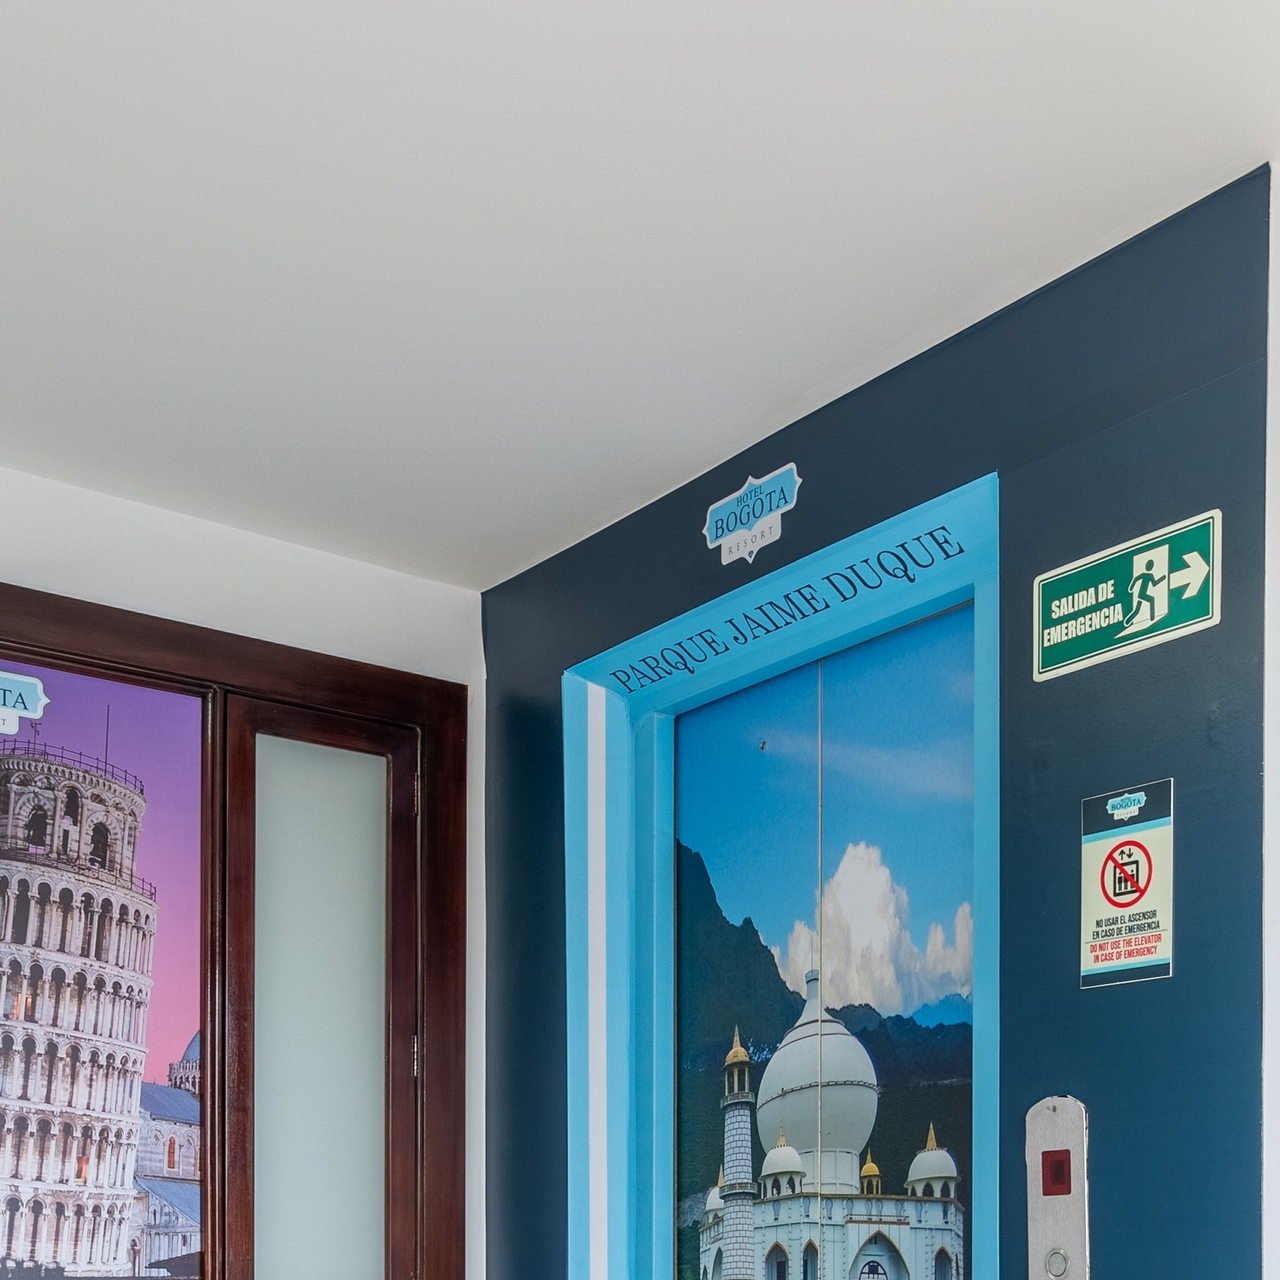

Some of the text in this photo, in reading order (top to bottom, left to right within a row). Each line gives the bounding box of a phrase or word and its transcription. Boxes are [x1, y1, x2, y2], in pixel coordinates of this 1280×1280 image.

[736, 485, 765, 507] HOTEL
[714, 485, 789, 540] BOGOTA
[728, 526, 774, 555] RESORT
[609, 525, 966, 694] PARQUE JAIME DUQUE
[1050, 579, 1115, 620] SALIDA DE
[1043, 602, 1124, 648] EMERGENCIA
[1111, 798, 1142, 811] BOGOTA
[1092, 920, 1161, 940] EN CASO DE EMERGENCIA
[1095, 909, 1157, 929] NO USAR EL ASCENSOR
[1090, 933, 1162, 953] DO NOT USE THE ELEVATOR
[1093, 945, 1158, 963] IN CASE OF EMERGENCY
